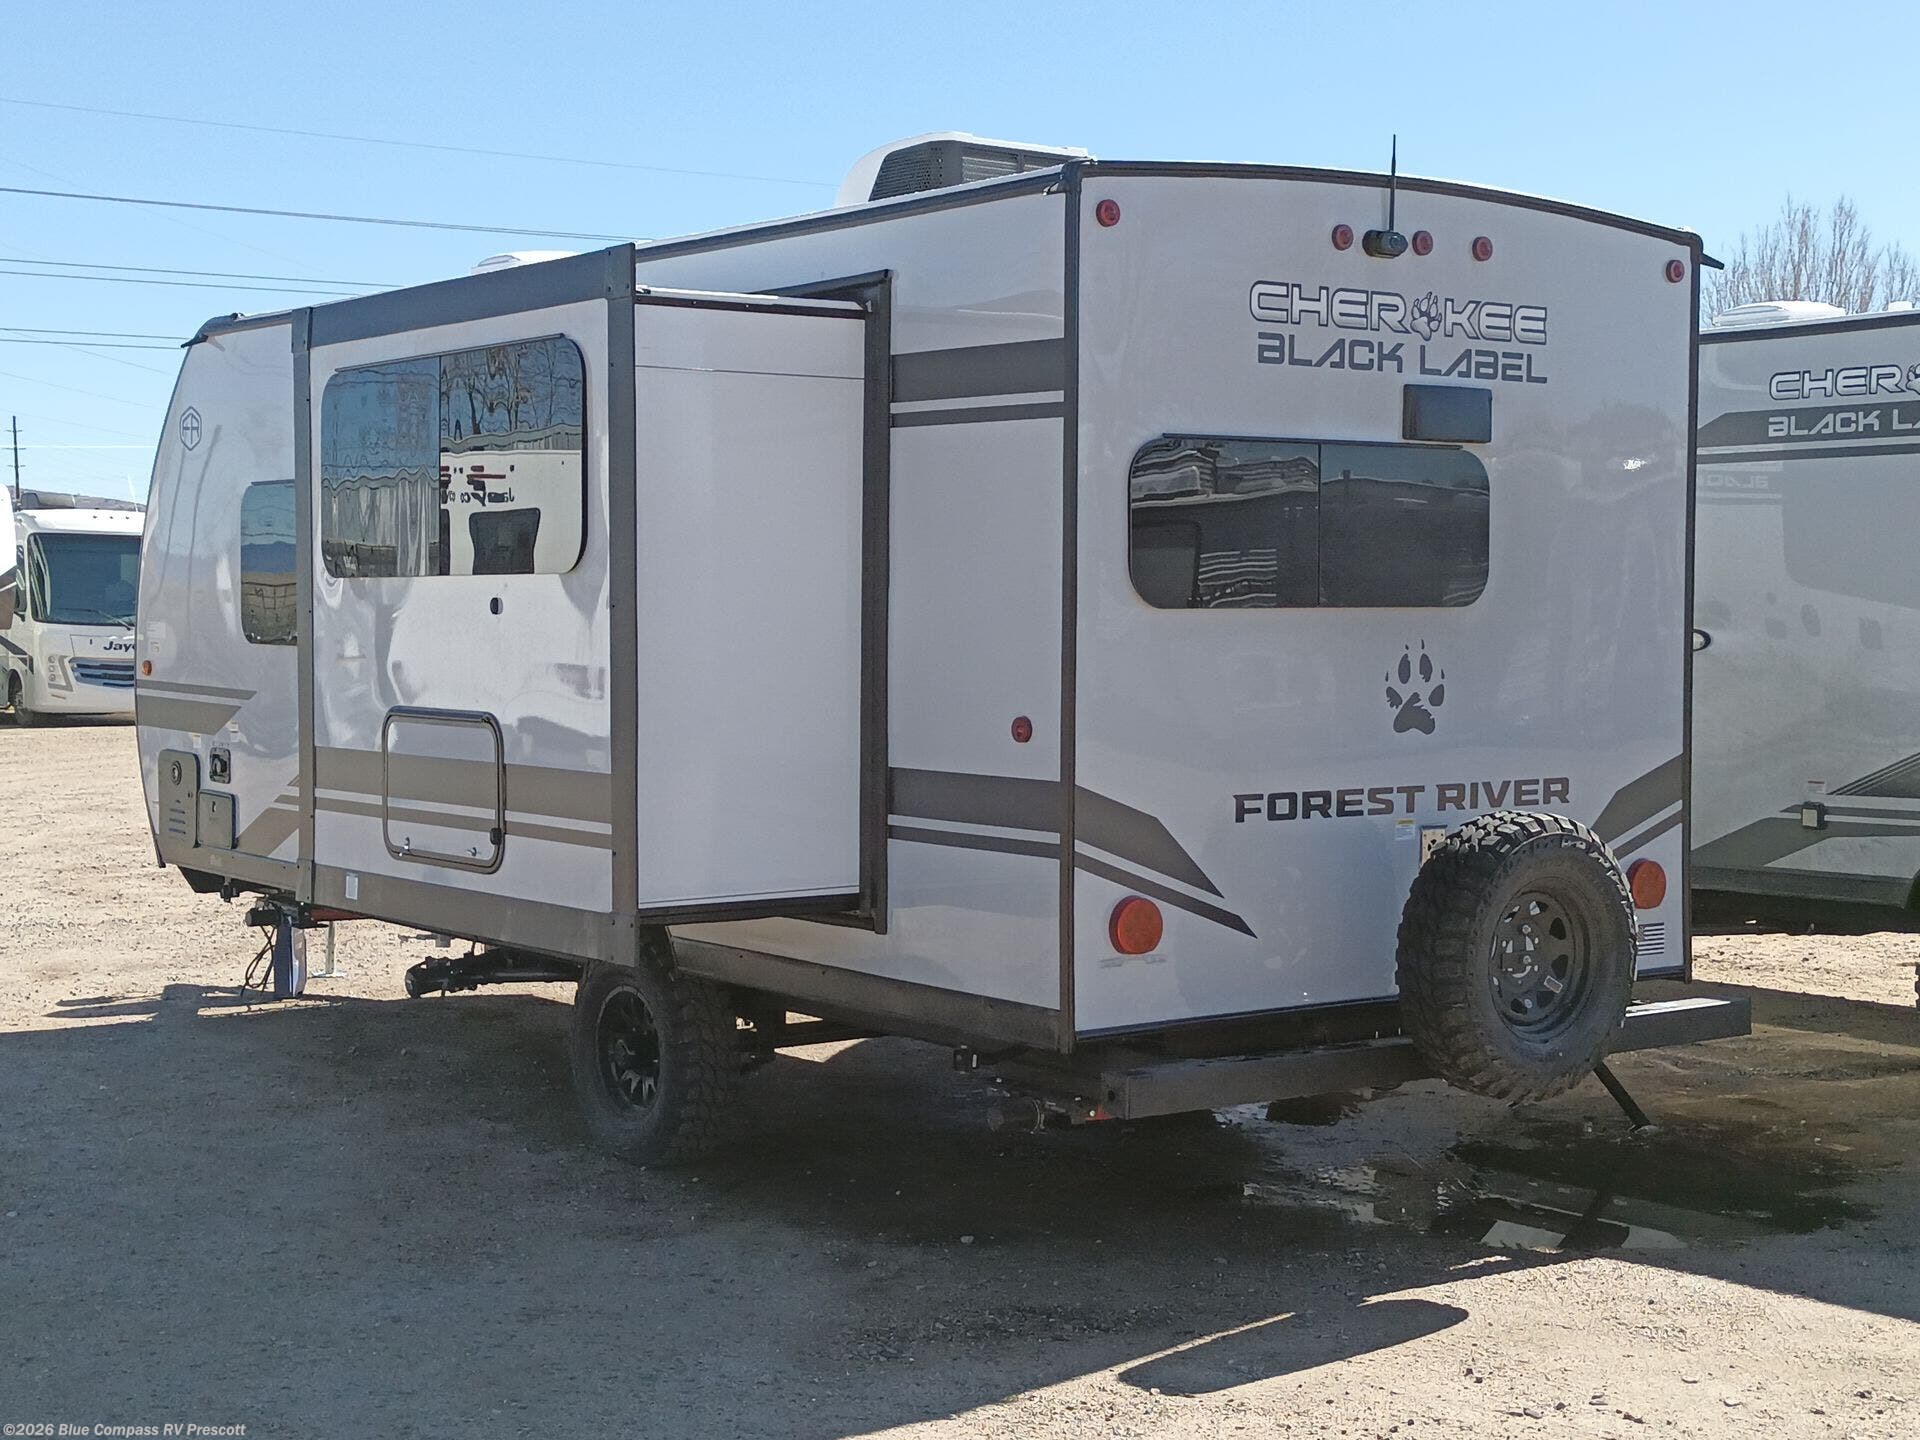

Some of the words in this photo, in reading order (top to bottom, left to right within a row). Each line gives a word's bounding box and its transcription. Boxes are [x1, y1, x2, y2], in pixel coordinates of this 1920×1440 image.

[1258, 331, 1405, 374] BLACK
[1419, 344, 1548, 384] LABEL
[1768, 410, 1881, 437] BLACK
[1233, 785, 1425, 823] FOREST
[1436, 777, 1570, 811] RIVER
